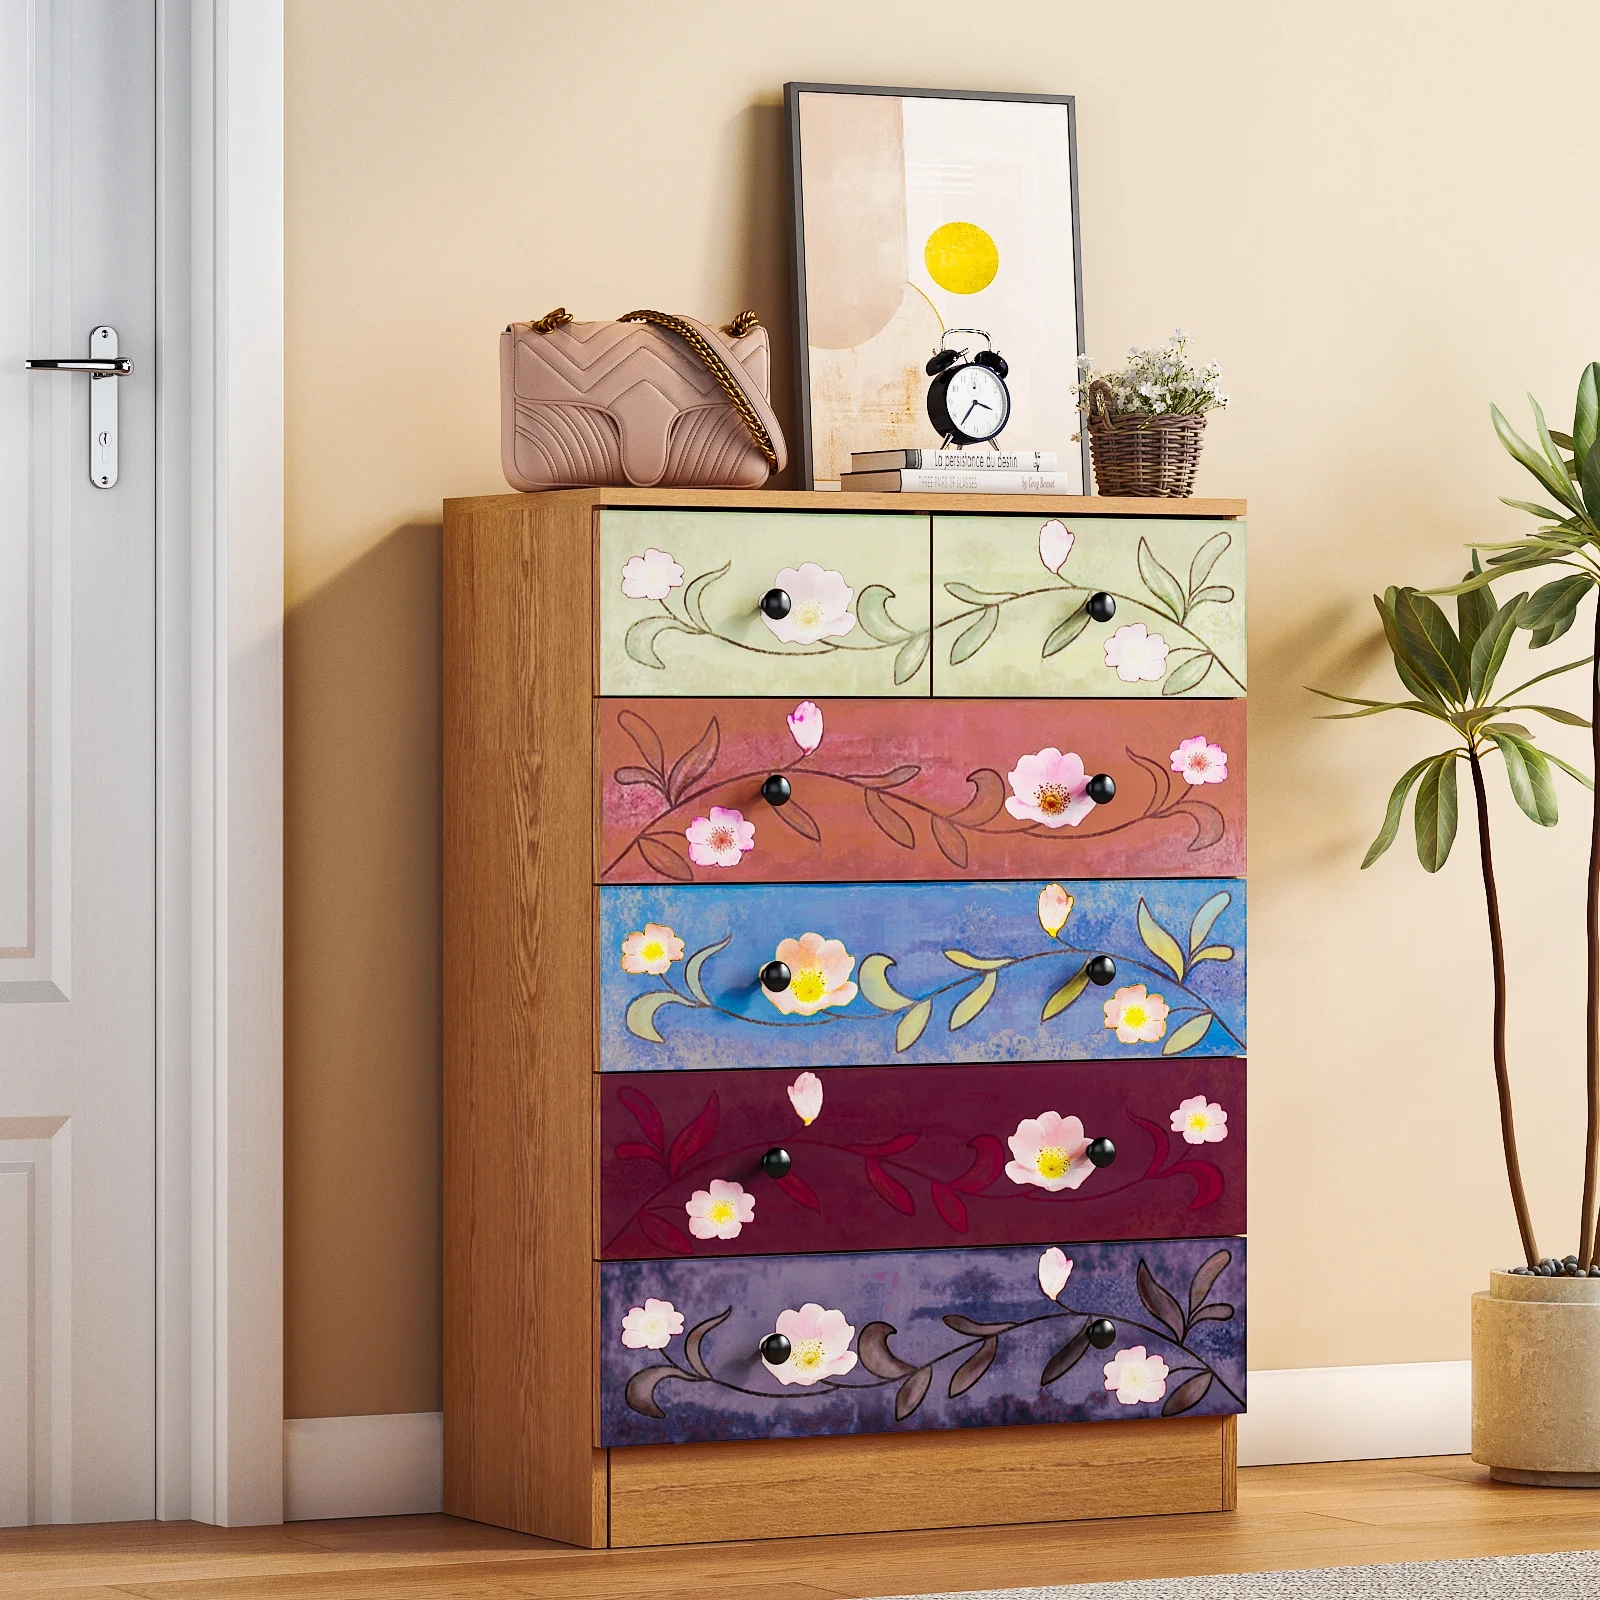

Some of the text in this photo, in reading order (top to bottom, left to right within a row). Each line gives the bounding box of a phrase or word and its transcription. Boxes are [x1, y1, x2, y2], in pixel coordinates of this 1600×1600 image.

[970, 371, 978, 380] 12
[934, 451, 1018, 470] La persistance du destin
[918, 475, 933, 488] THREE
[949, 476, 956, 489] OF
[957, 476, 978, 489] GLASSES
[1021, 476, 1028, 490] by
